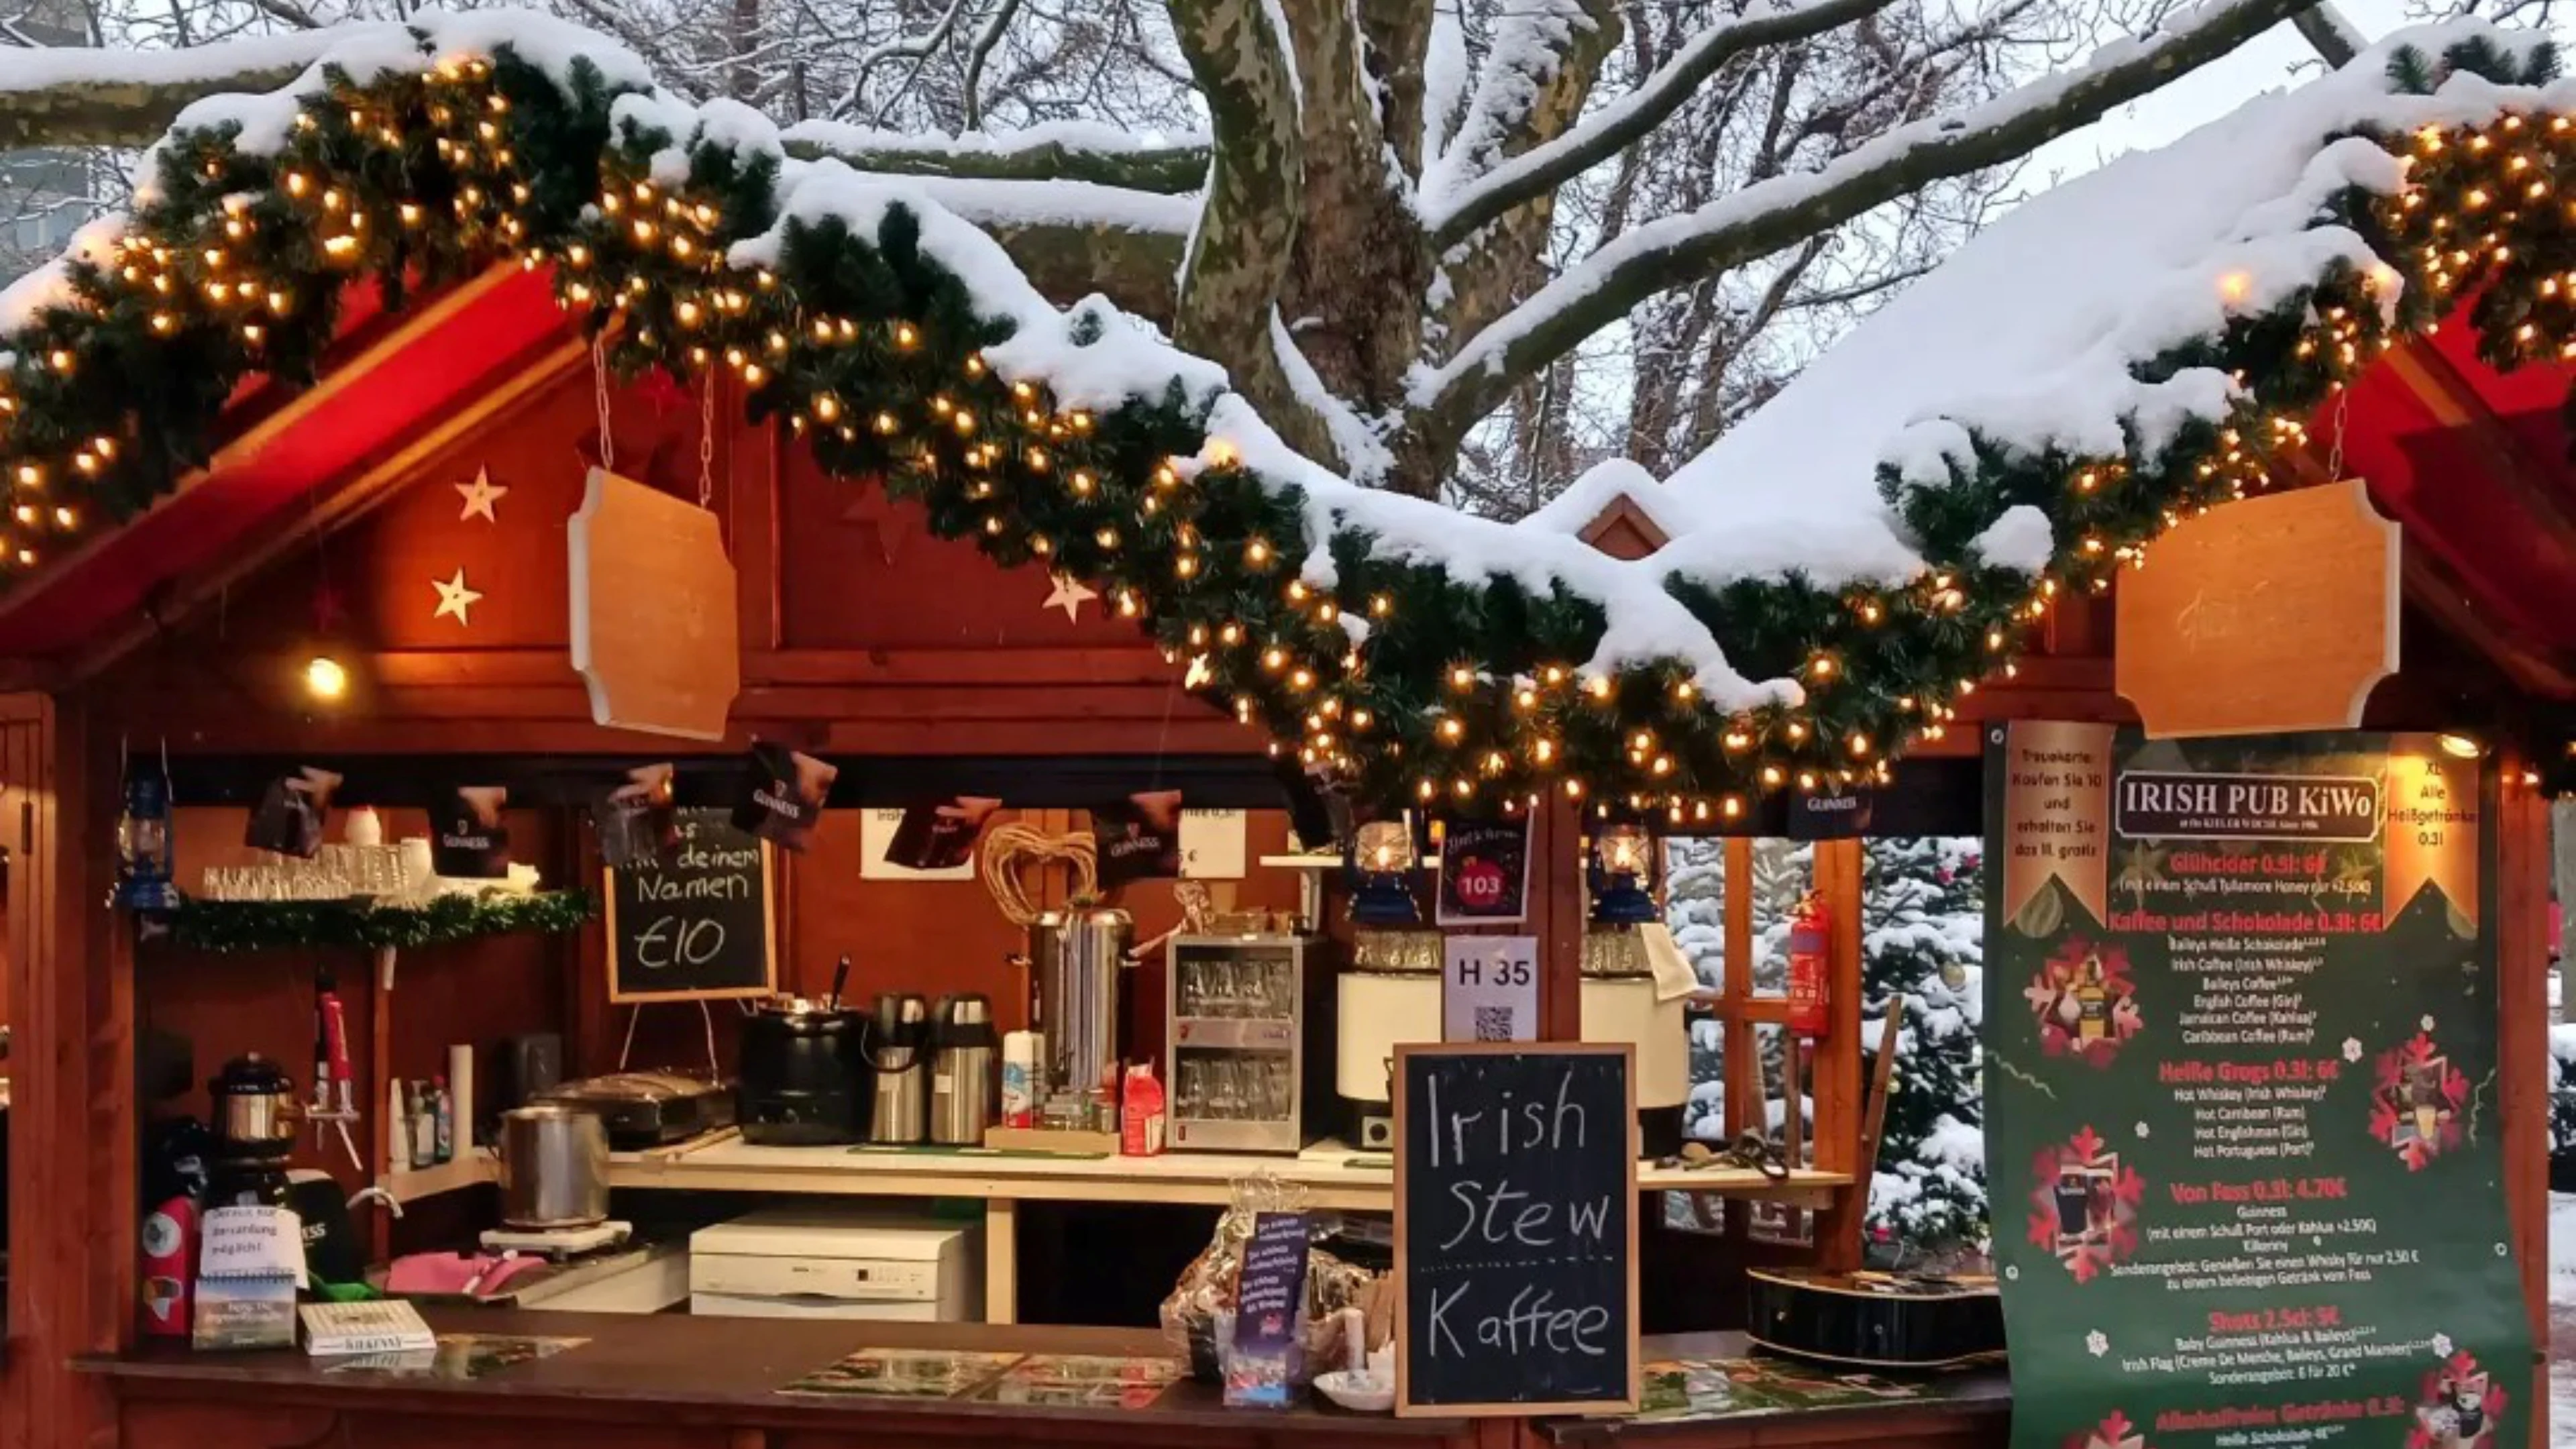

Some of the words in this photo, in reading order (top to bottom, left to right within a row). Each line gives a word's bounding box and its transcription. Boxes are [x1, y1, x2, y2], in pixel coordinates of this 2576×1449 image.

[2425, 761, 2441, 775] XL
[2063, 773, 2083, 787] Sie
[2126, 782, 2217, 814] IRISH
[2227, 784, 2290, 815] PUB
[2298, 786, 2371, 817] KiWo
[2420, 785, 2446, 799] Alle
[2044, 797, 2070, 810] und
[2017, 819, 2071, 833] erhalten
[2076, 821, 2096, 834] Sie
[677, 843, 759, 869] deinem
[2169, 852, 2258, 874] Glühcider
[638, 873, 749, 903] Namen
[1462, 875, 1501, 895] 103
[2108, 911, 2167, 932] Kaffee
[2171, 911, 2209, 932] und
[2212, 910, 2316, 932] Schokolade
[633, 915, 726, 969] €10
[1458, 957, 1481, 986] H
[1493, 959, 1531, 987] 35
[2217, 1060, 2270, 1085] Grogs
[2174, 1088, 2195, 1102] Hot
[1428, 1071, 1586, 1168] Irish
[2195, 1107, 2216, 1121] Hot
[2194, 1126, 2216, 1140] Hot
[2194, 1144, 2214, 1159] Hot
[2170, 1182, 2207, 1204] Von
[1439, 1179, 1611, 1252] Stew
[2270, 1221, 2296, 1236] oder
[1429, 1279, 1609, 1360] Kaffee
